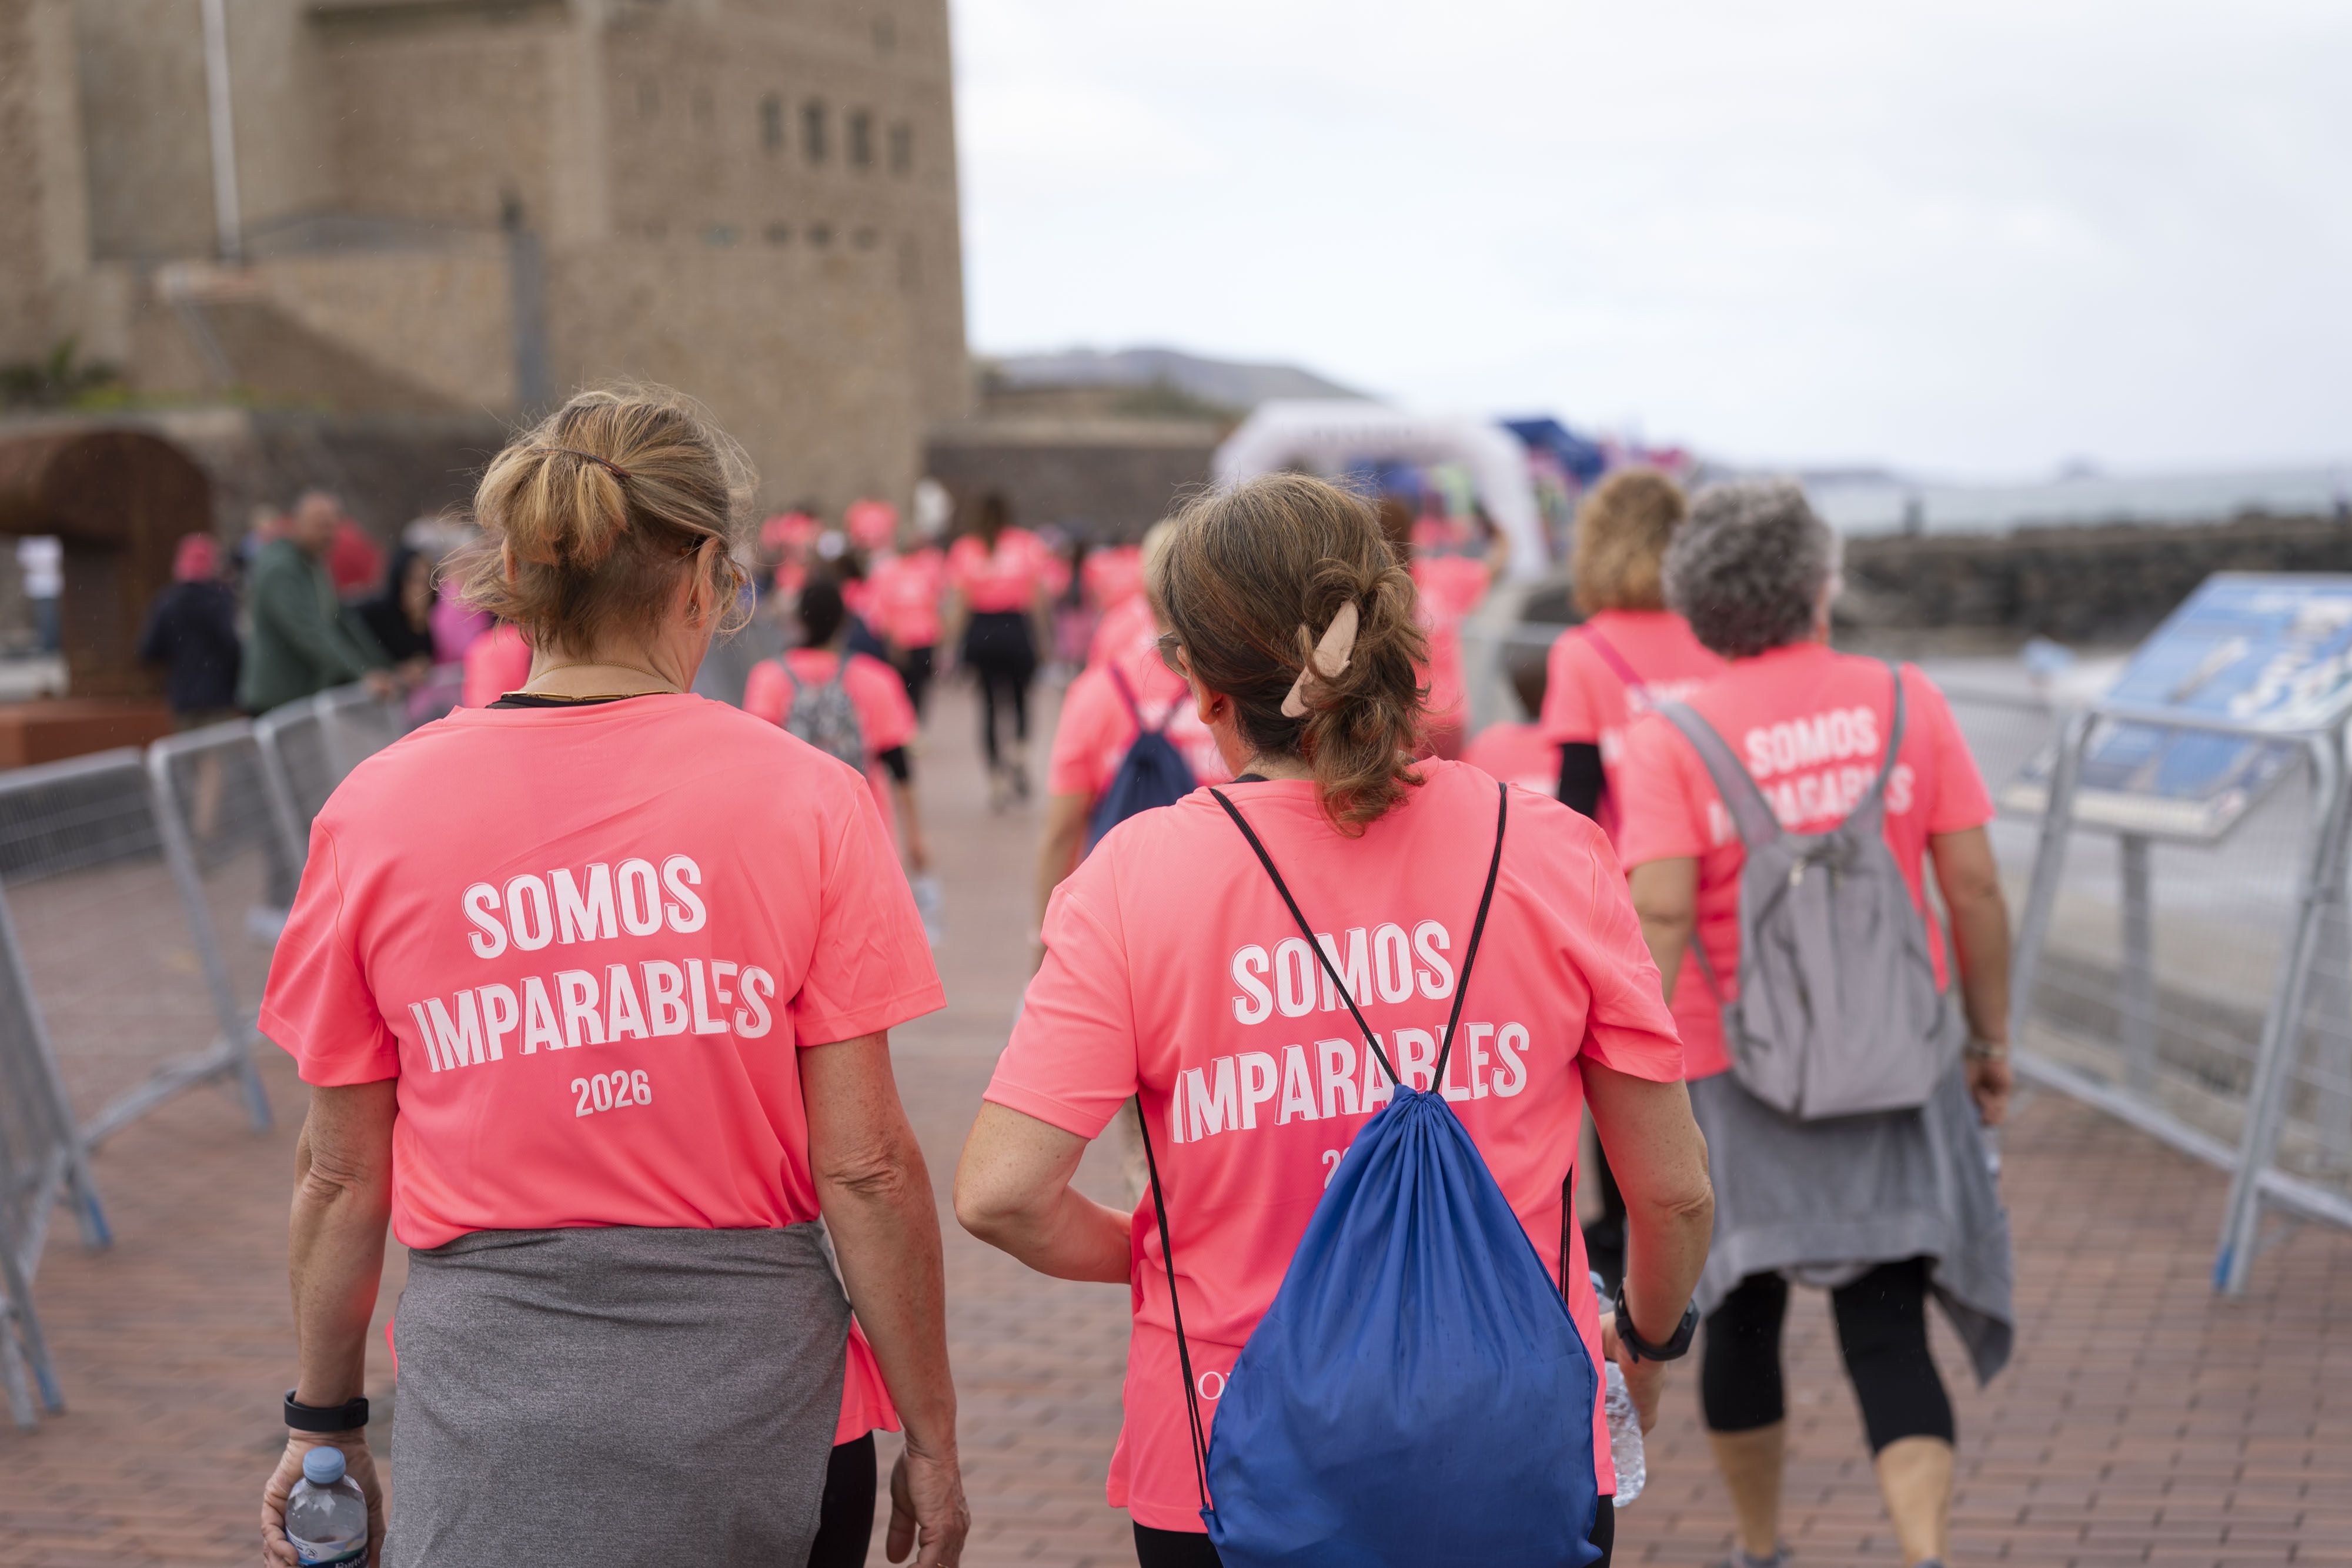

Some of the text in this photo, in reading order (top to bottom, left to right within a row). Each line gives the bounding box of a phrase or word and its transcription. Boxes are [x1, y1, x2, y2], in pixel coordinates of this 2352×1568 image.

[1745, 707, 1880, 778] SOMOS
[461, 854, 706, 959] SOMOS
[408, 958, 775, 1072] IMPARABLES
[1230, 920, 1454, 1025] SOMOS
[571, 1069, 652, 1118] 2026
